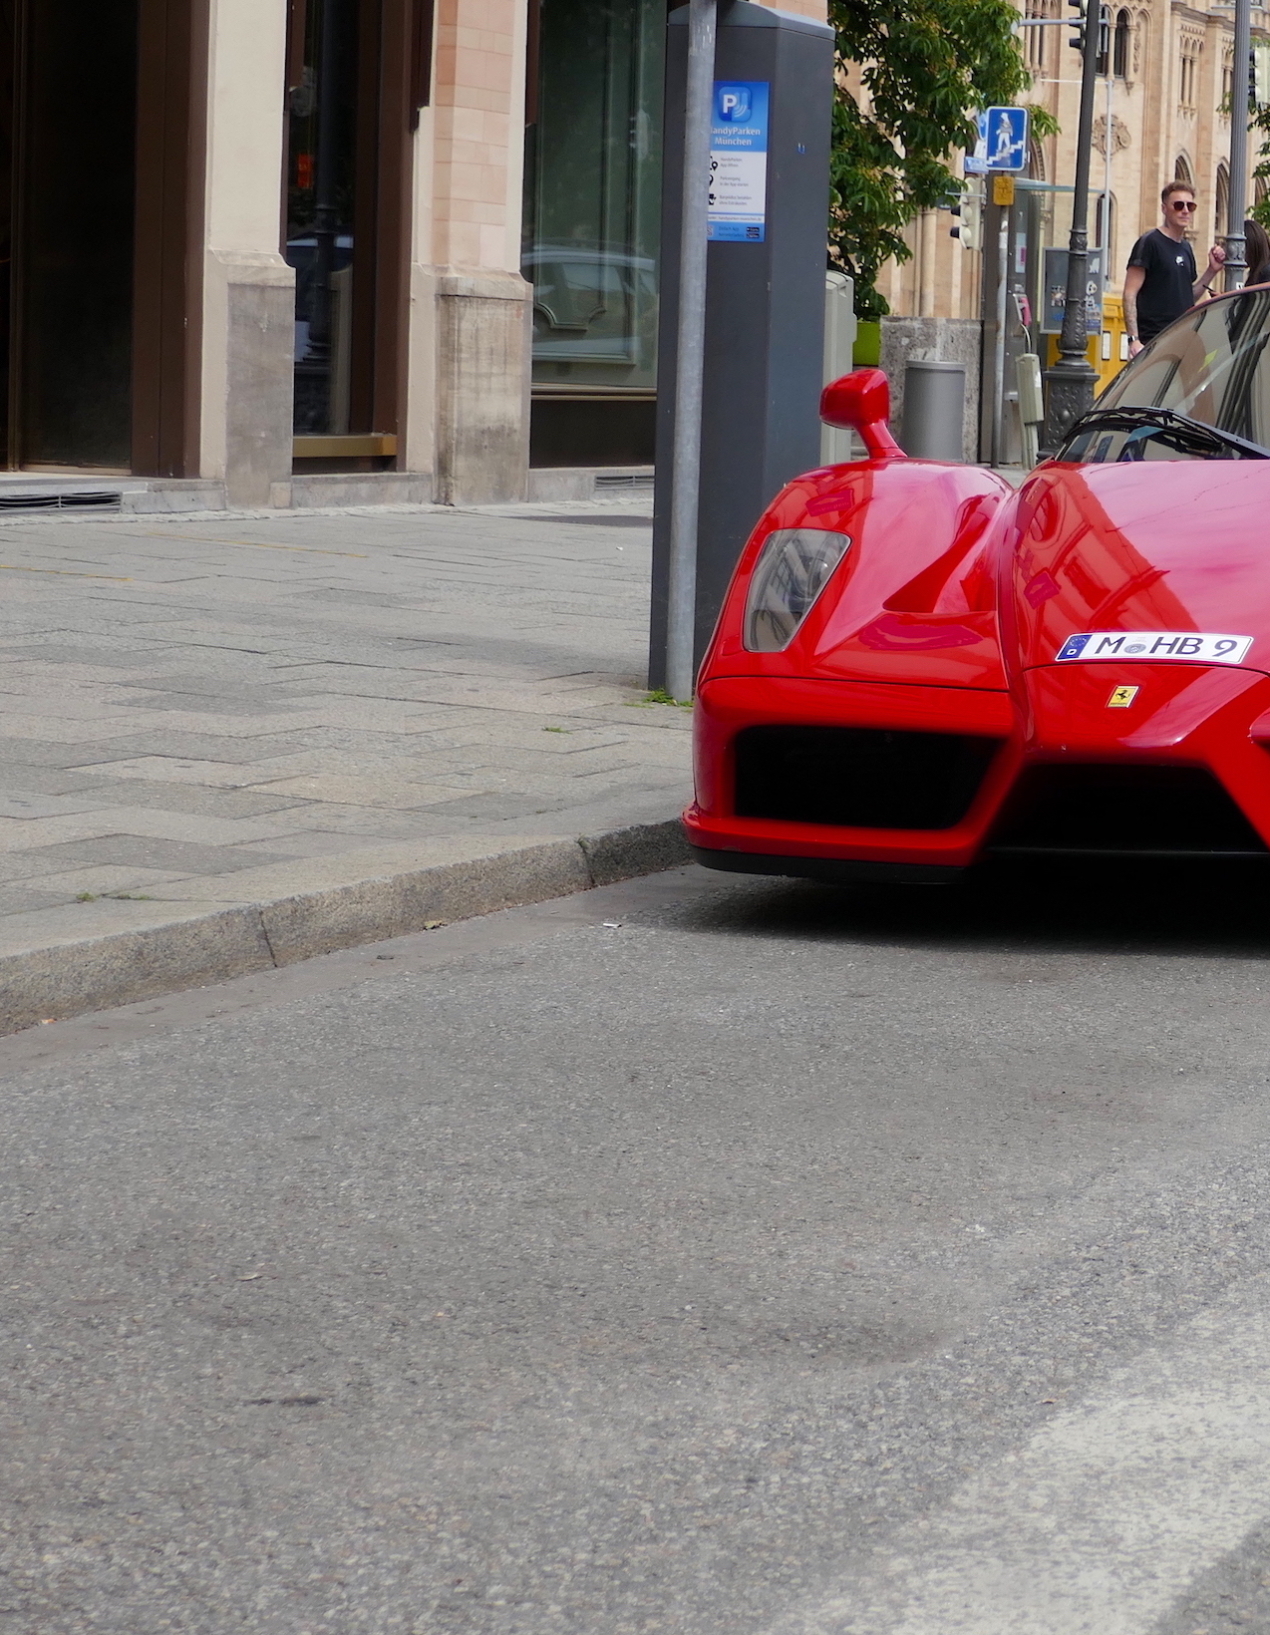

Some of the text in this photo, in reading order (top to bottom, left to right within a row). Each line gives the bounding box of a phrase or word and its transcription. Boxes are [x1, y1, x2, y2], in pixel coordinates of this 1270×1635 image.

[722, 94, 737, 114] P
[715, 137, 752, 146] München
[1066, 636, 1238, 657] D M HB 9
